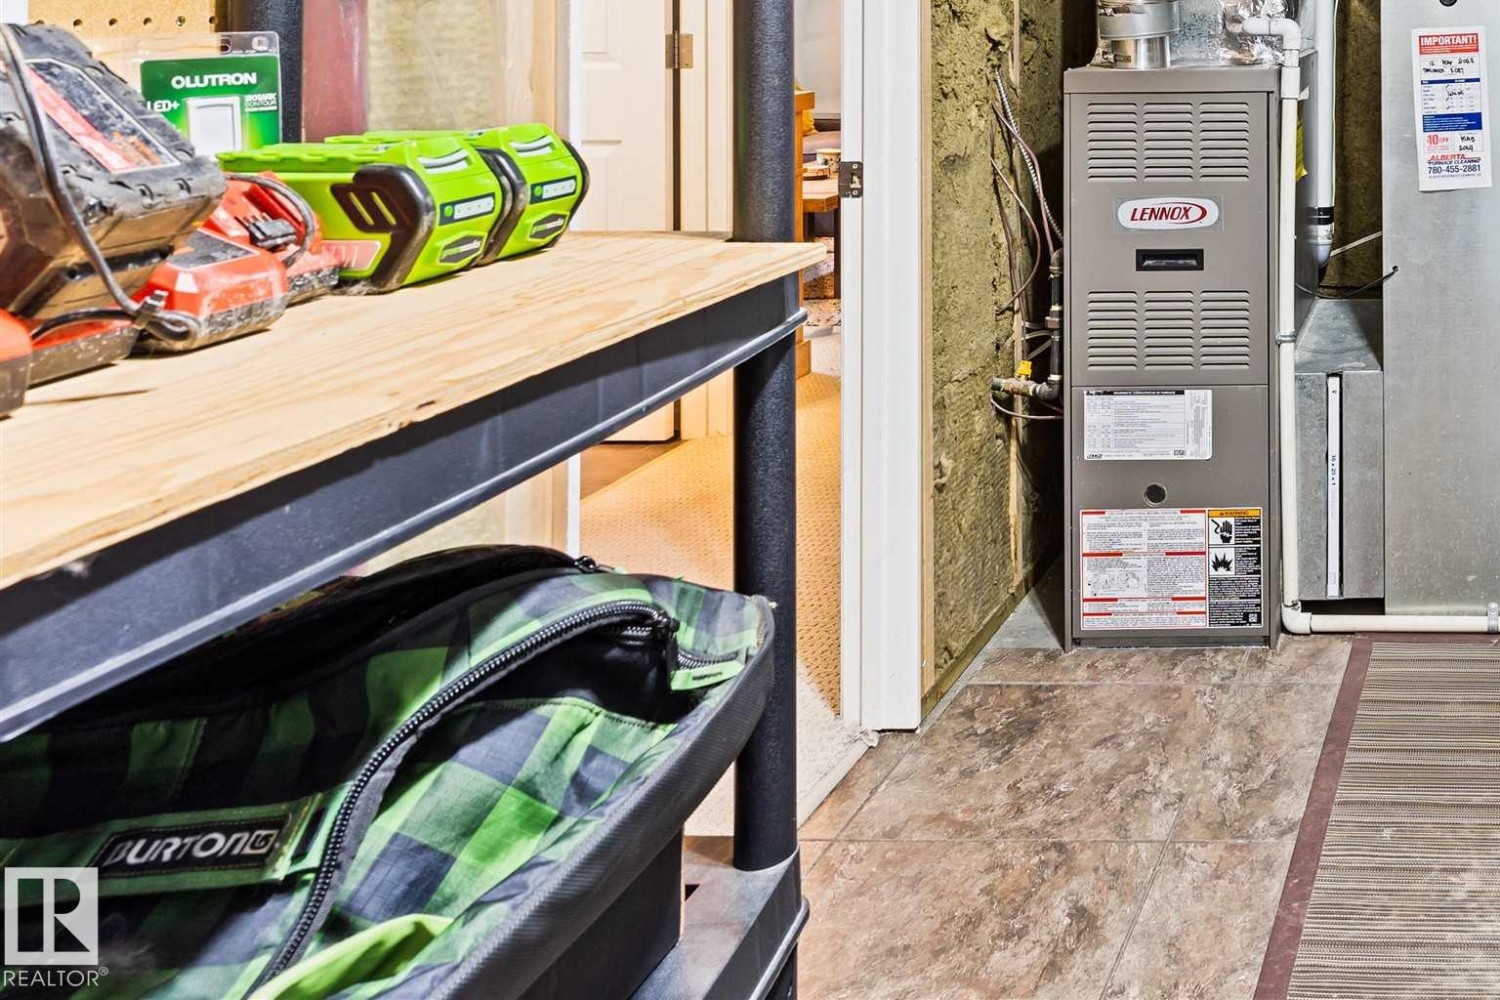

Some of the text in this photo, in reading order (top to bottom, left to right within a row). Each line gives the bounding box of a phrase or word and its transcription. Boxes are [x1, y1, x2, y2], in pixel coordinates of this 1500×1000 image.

[1420, 34, 1477, 46] IMPORTANT!
[1430, 153, 1466, 161] ALBERTA
[1428, 164, 1481, 174] 780-455-2881
[1130, 206, 1192, 221] LENNOX
[102, 831, 248, 867] BURTON
